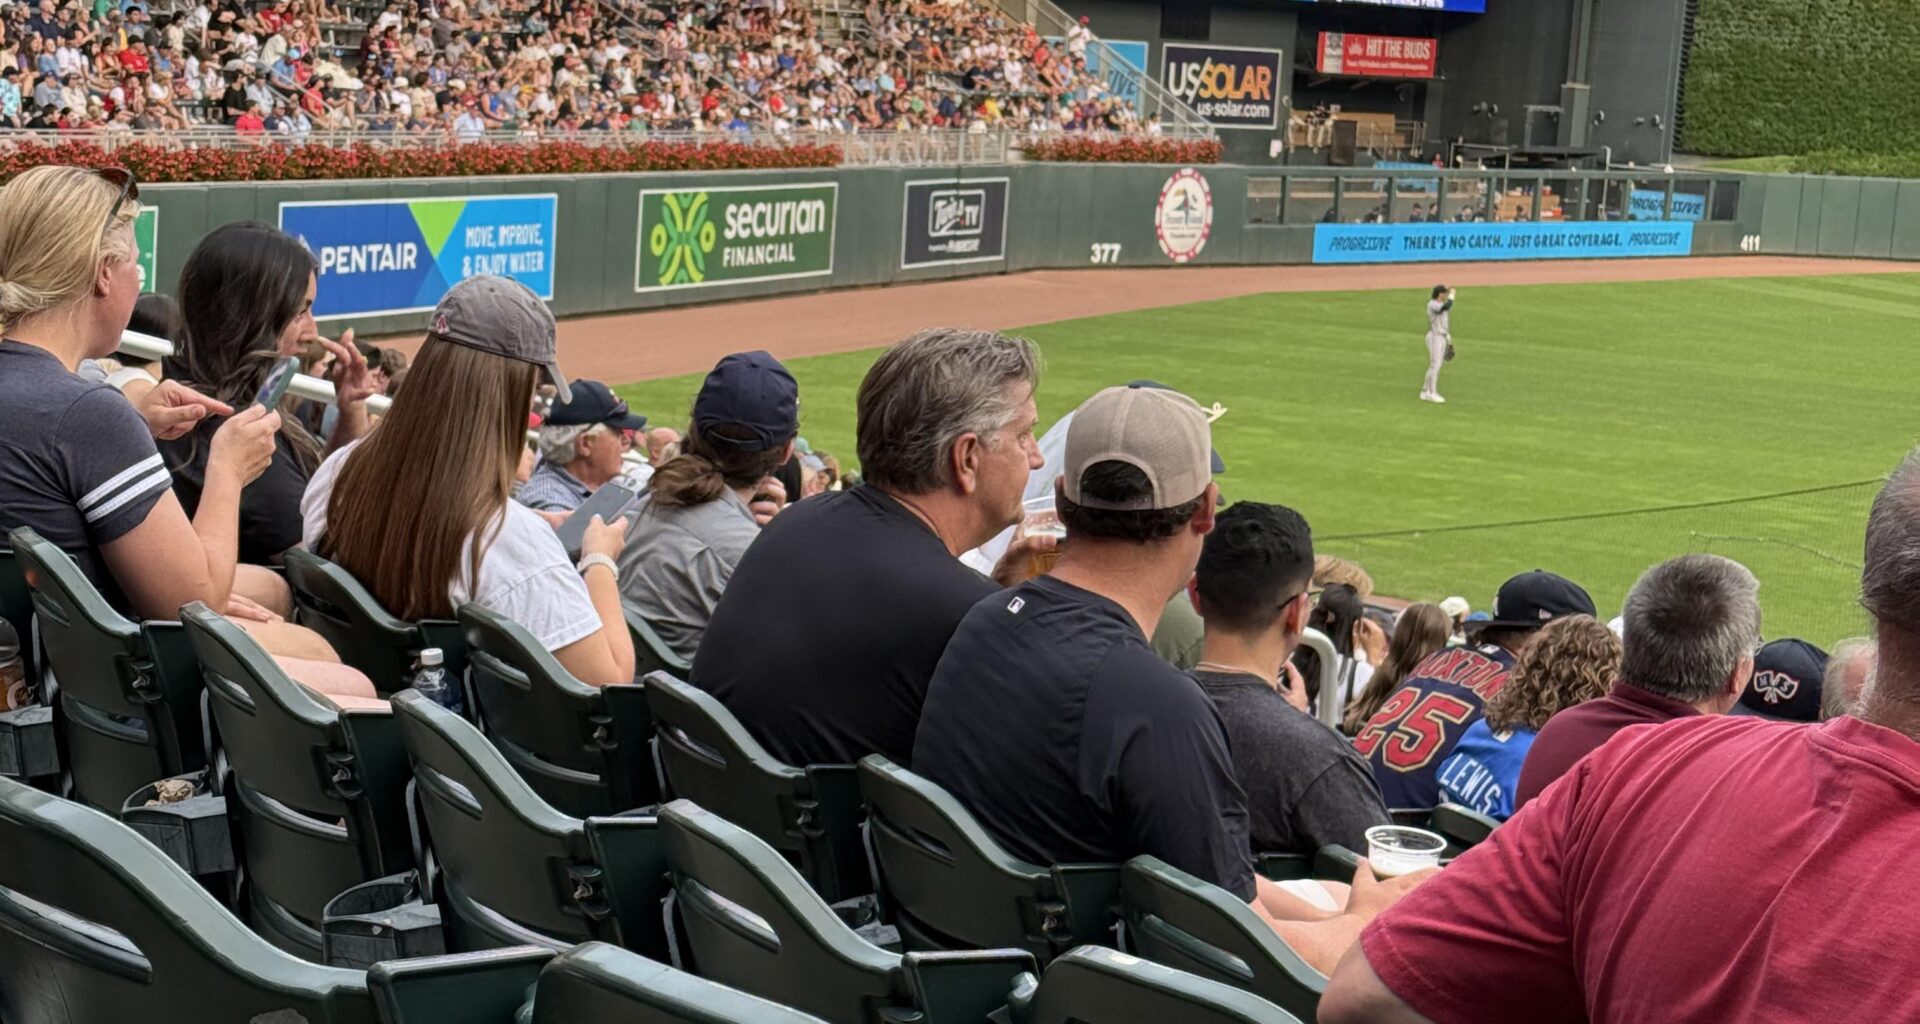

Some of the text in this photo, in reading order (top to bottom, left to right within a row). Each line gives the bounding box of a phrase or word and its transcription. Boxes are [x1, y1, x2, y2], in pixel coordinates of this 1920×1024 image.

[1366, 38, 1430, 60] HIT THE BUDS
[1197, 101, 1270, 118] us-solar.com
[724, 198, 825, 240] securian
[465, 223, 544, 249] MOVE, IMPROVE,
[1329, 232, 1680, 251] PROGRESSIVE THERE'S NO CATCH. JUST GREAT COVERAGE. PROGRESSIVE
[1740, 234, 1761, 251] 411
[320, 242, 418, 276] PENTAIR
[462, 250, 544, 277] & ENJOY WATER
[722, 242, 796, 268] FINANCIAL
[1090, 242, 1122, 264] 377
[1353, 686, 1475, 772] 25
[1438, 753, 1501, 816] LEWIS
